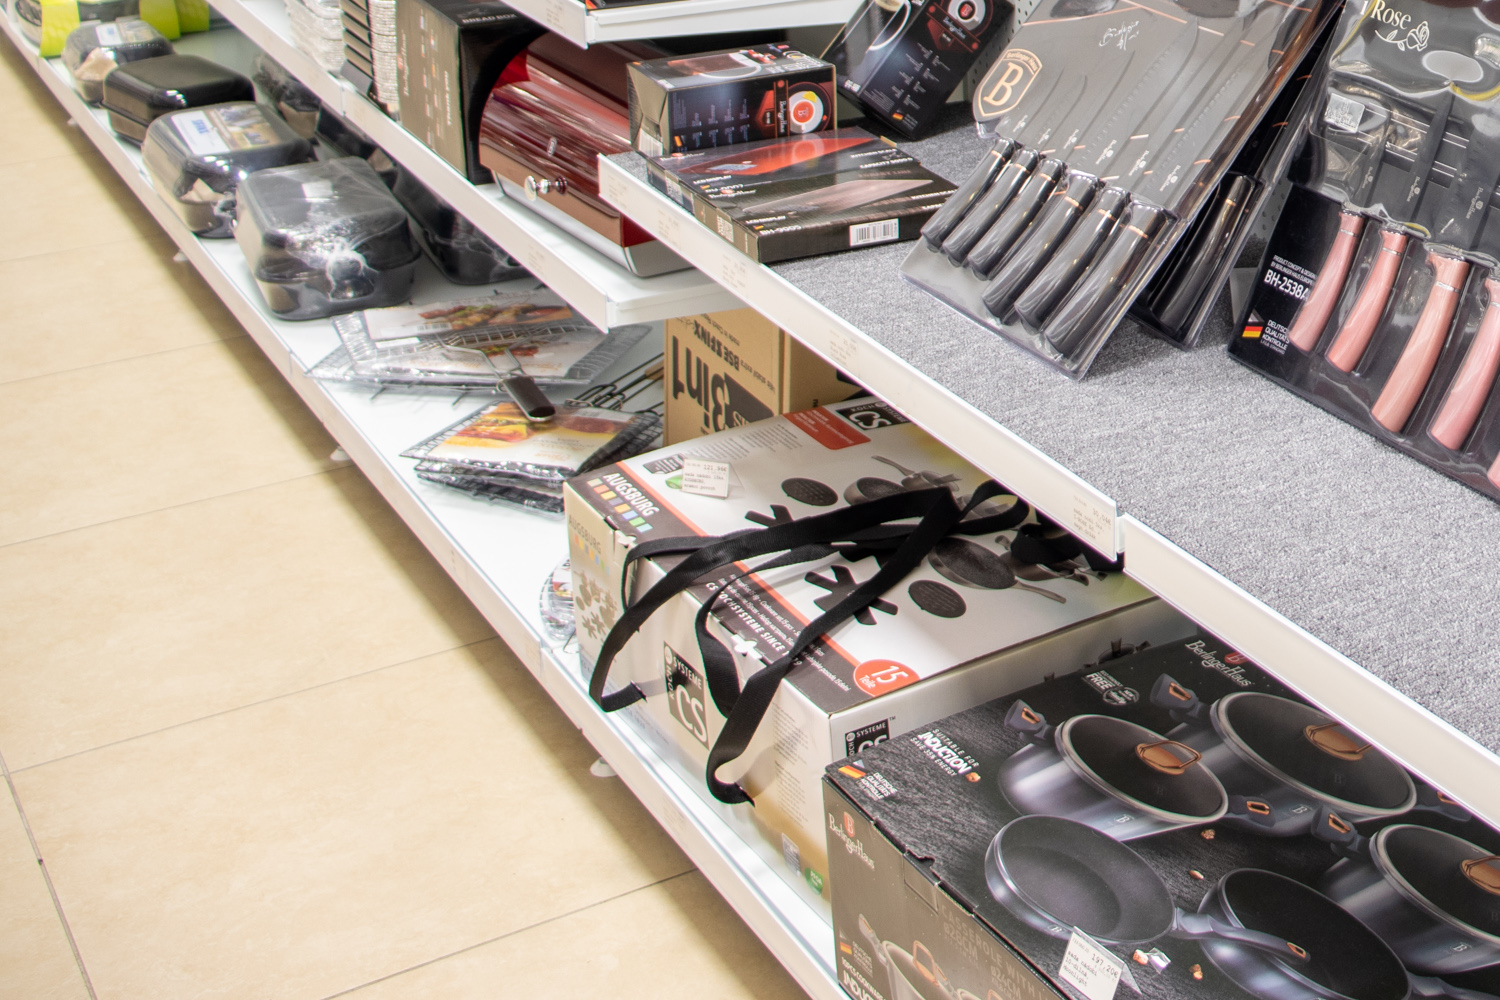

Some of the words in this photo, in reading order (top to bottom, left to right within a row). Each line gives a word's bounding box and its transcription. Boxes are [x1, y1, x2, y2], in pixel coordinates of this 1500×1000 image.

[462, 15, 496, 24] BREAD
[497, 13, 517, 21] BOX
[983, 62, 1024, 106] B
[1263, 268, 1310, 301] BH-2538A
[722, 348, 741, 372] BSE
[671, 334, 727, 433] 3in1
[849, 410, 892, 429] CS
[850, 403, 875, 414] KOCH
[602, 472, 661, 517] AUGSBURG
[720, 591, 765, 636] OCHSYSTEME
[673, 655, 703, 690] SYSTEME
[870, 665, 909, 683] 15
[1184, 639, 1251, 688] BerlingerHaus
[859, 674, 876, 689] Teile
[675, 684, 707, 743] CS
[855, 722, 887, 738] SYSTEME
[910, 737, 925, 750] SAVE
[934, 758, 957, 777] ENERGY
[917, 731, 972, 775] INDUCTION
[932, 728, 965, 756] SUITABLE
[828, 812, 875, 871] BerlingerHaus
[941, 906, 1004, 970] CASSEROLE
[1091, 953, 1119, 979] 197,20€
